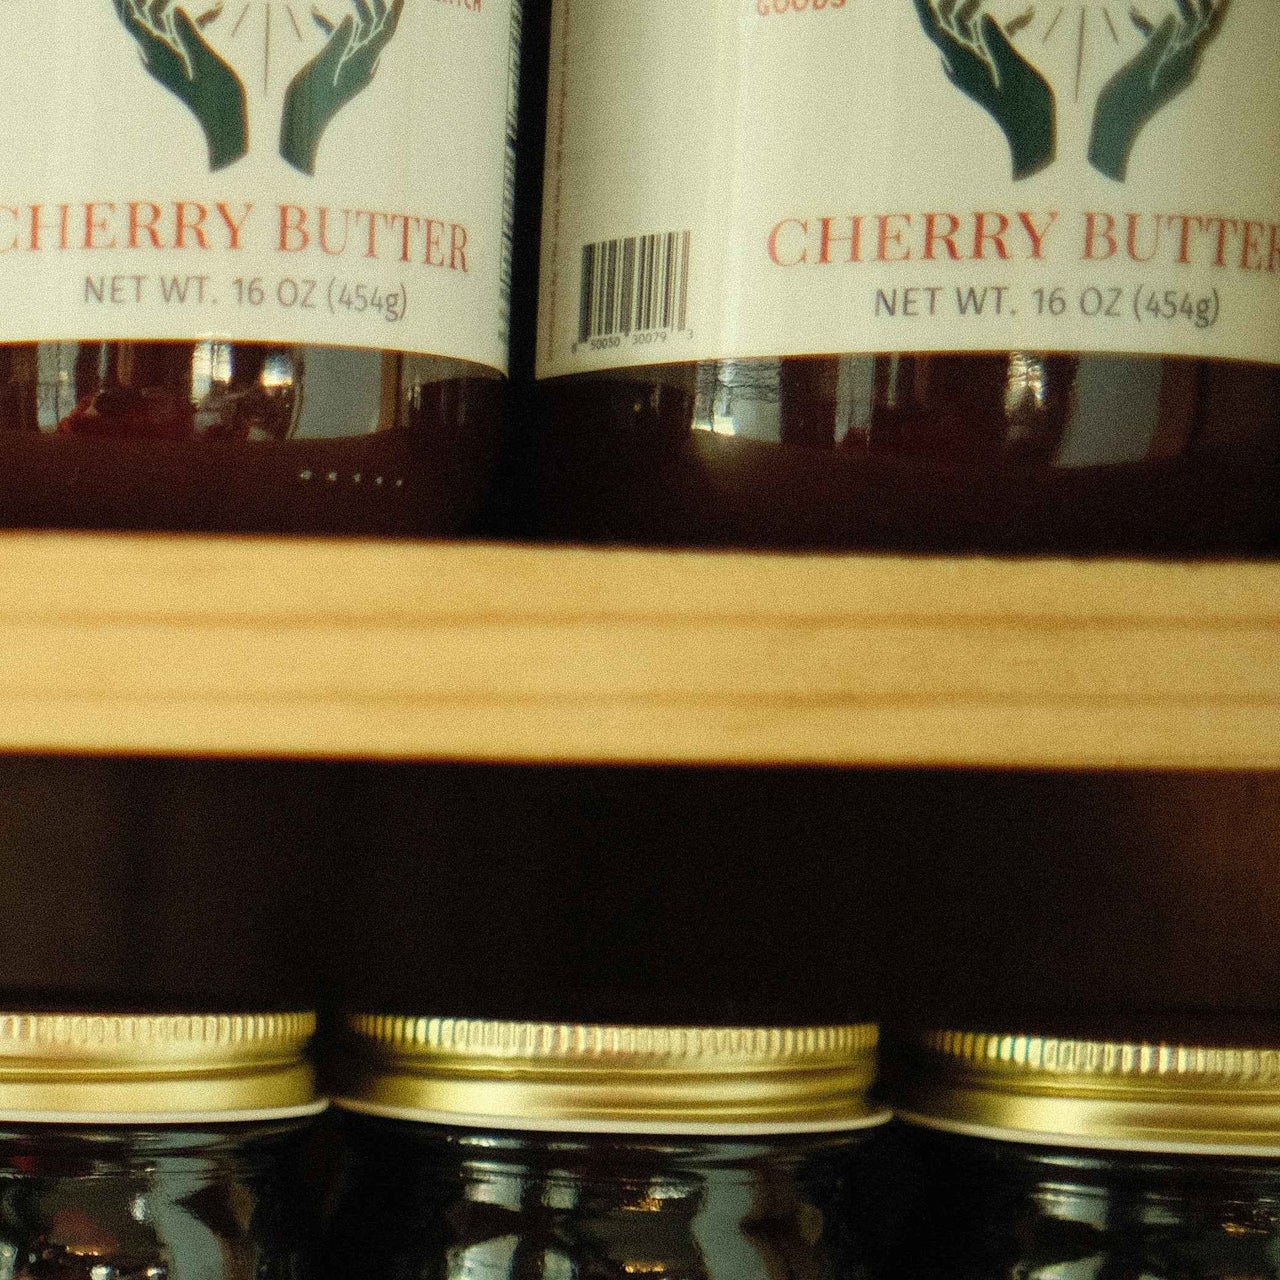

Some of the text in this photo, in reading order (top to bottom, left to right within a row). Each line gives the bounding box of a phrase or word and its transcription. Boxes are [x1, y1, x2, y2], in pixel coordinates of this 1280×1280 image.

[276, 202, 471, 273] BUTTER
[766, 210, 1059, 269] CHERRY
[82, 274, 409, 323] NET WT. 16 OZ (454g)
[873, 285, 1222, 330] NET WT. 16 OZ (454g)
